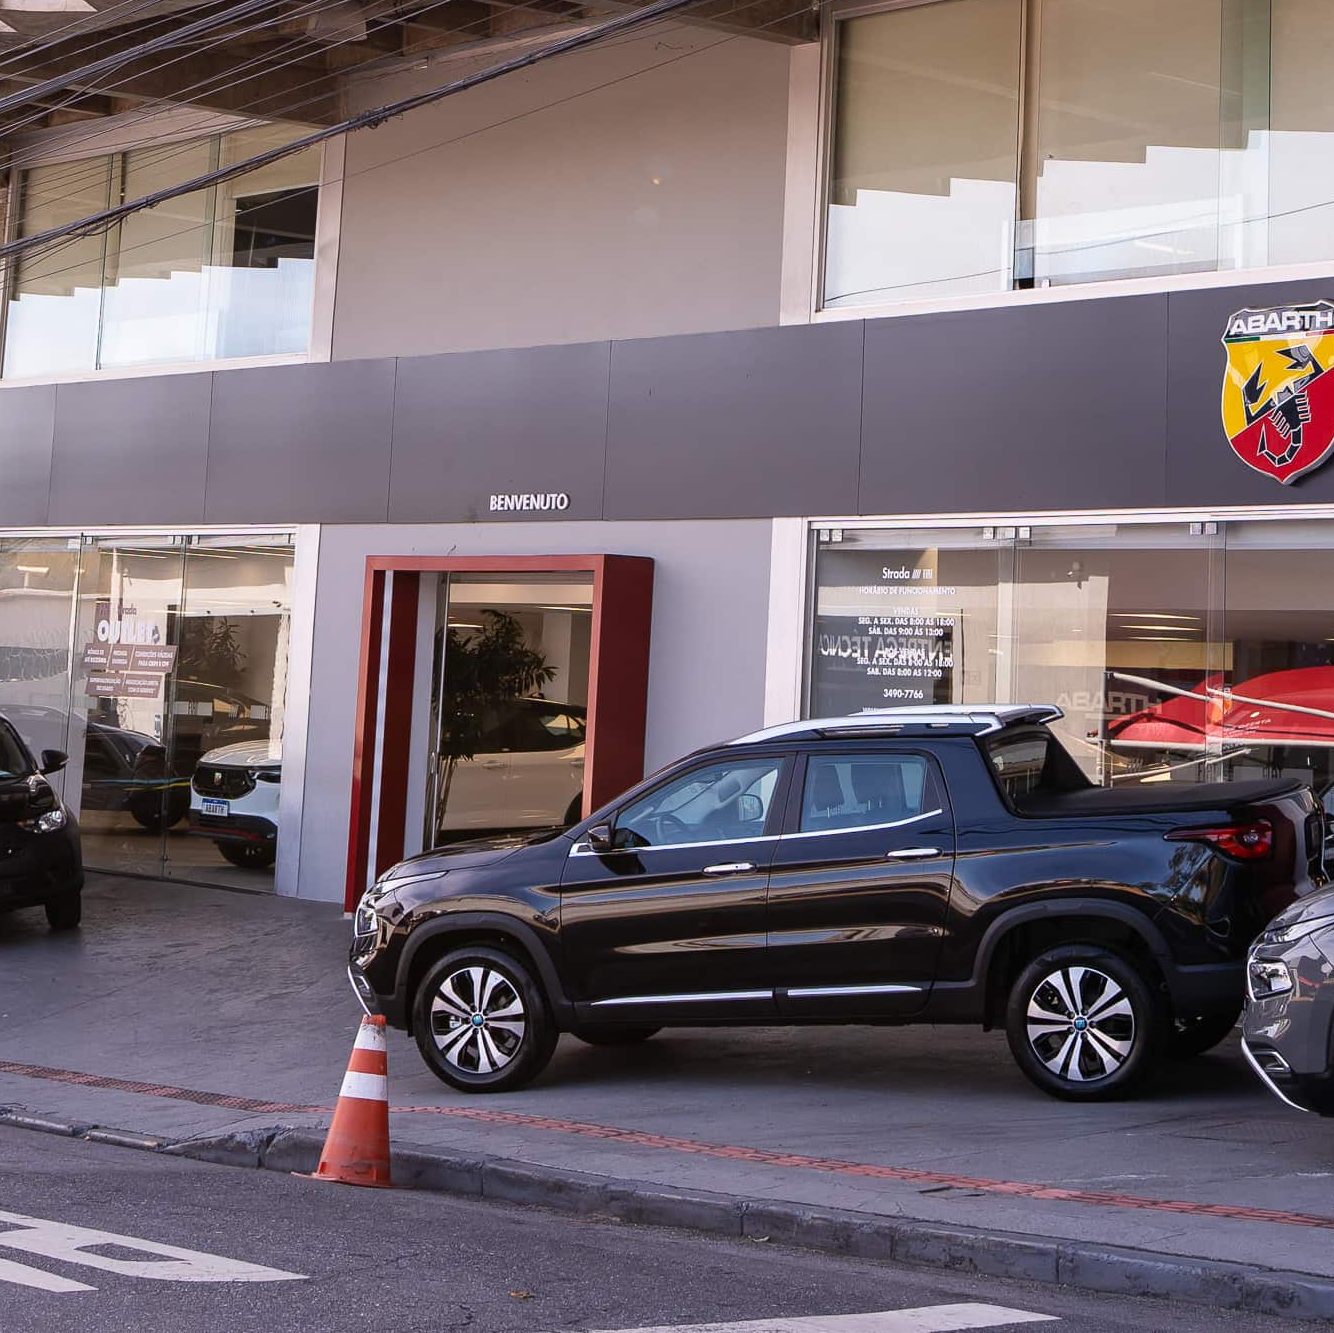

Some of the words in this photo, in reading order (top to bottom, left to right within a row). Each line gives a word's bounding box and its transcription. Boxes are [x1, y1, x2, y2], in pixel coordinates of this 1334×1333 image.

[1229, 311, 1334, 335] ABARTH
[490, 493, 569, 511] BENVENUTO
[882, 566, 910, 579] Strada
[899, 586, 956, 595] FUNCIONAMENTO
[895, 617, 908, 625] DAS
[884, 627, 897, 635] DAS
[898, 627, 913, 636] 9:00
[883, 668, 896, 676] DAS
[883, 689, 924, 699] 3490-7766
